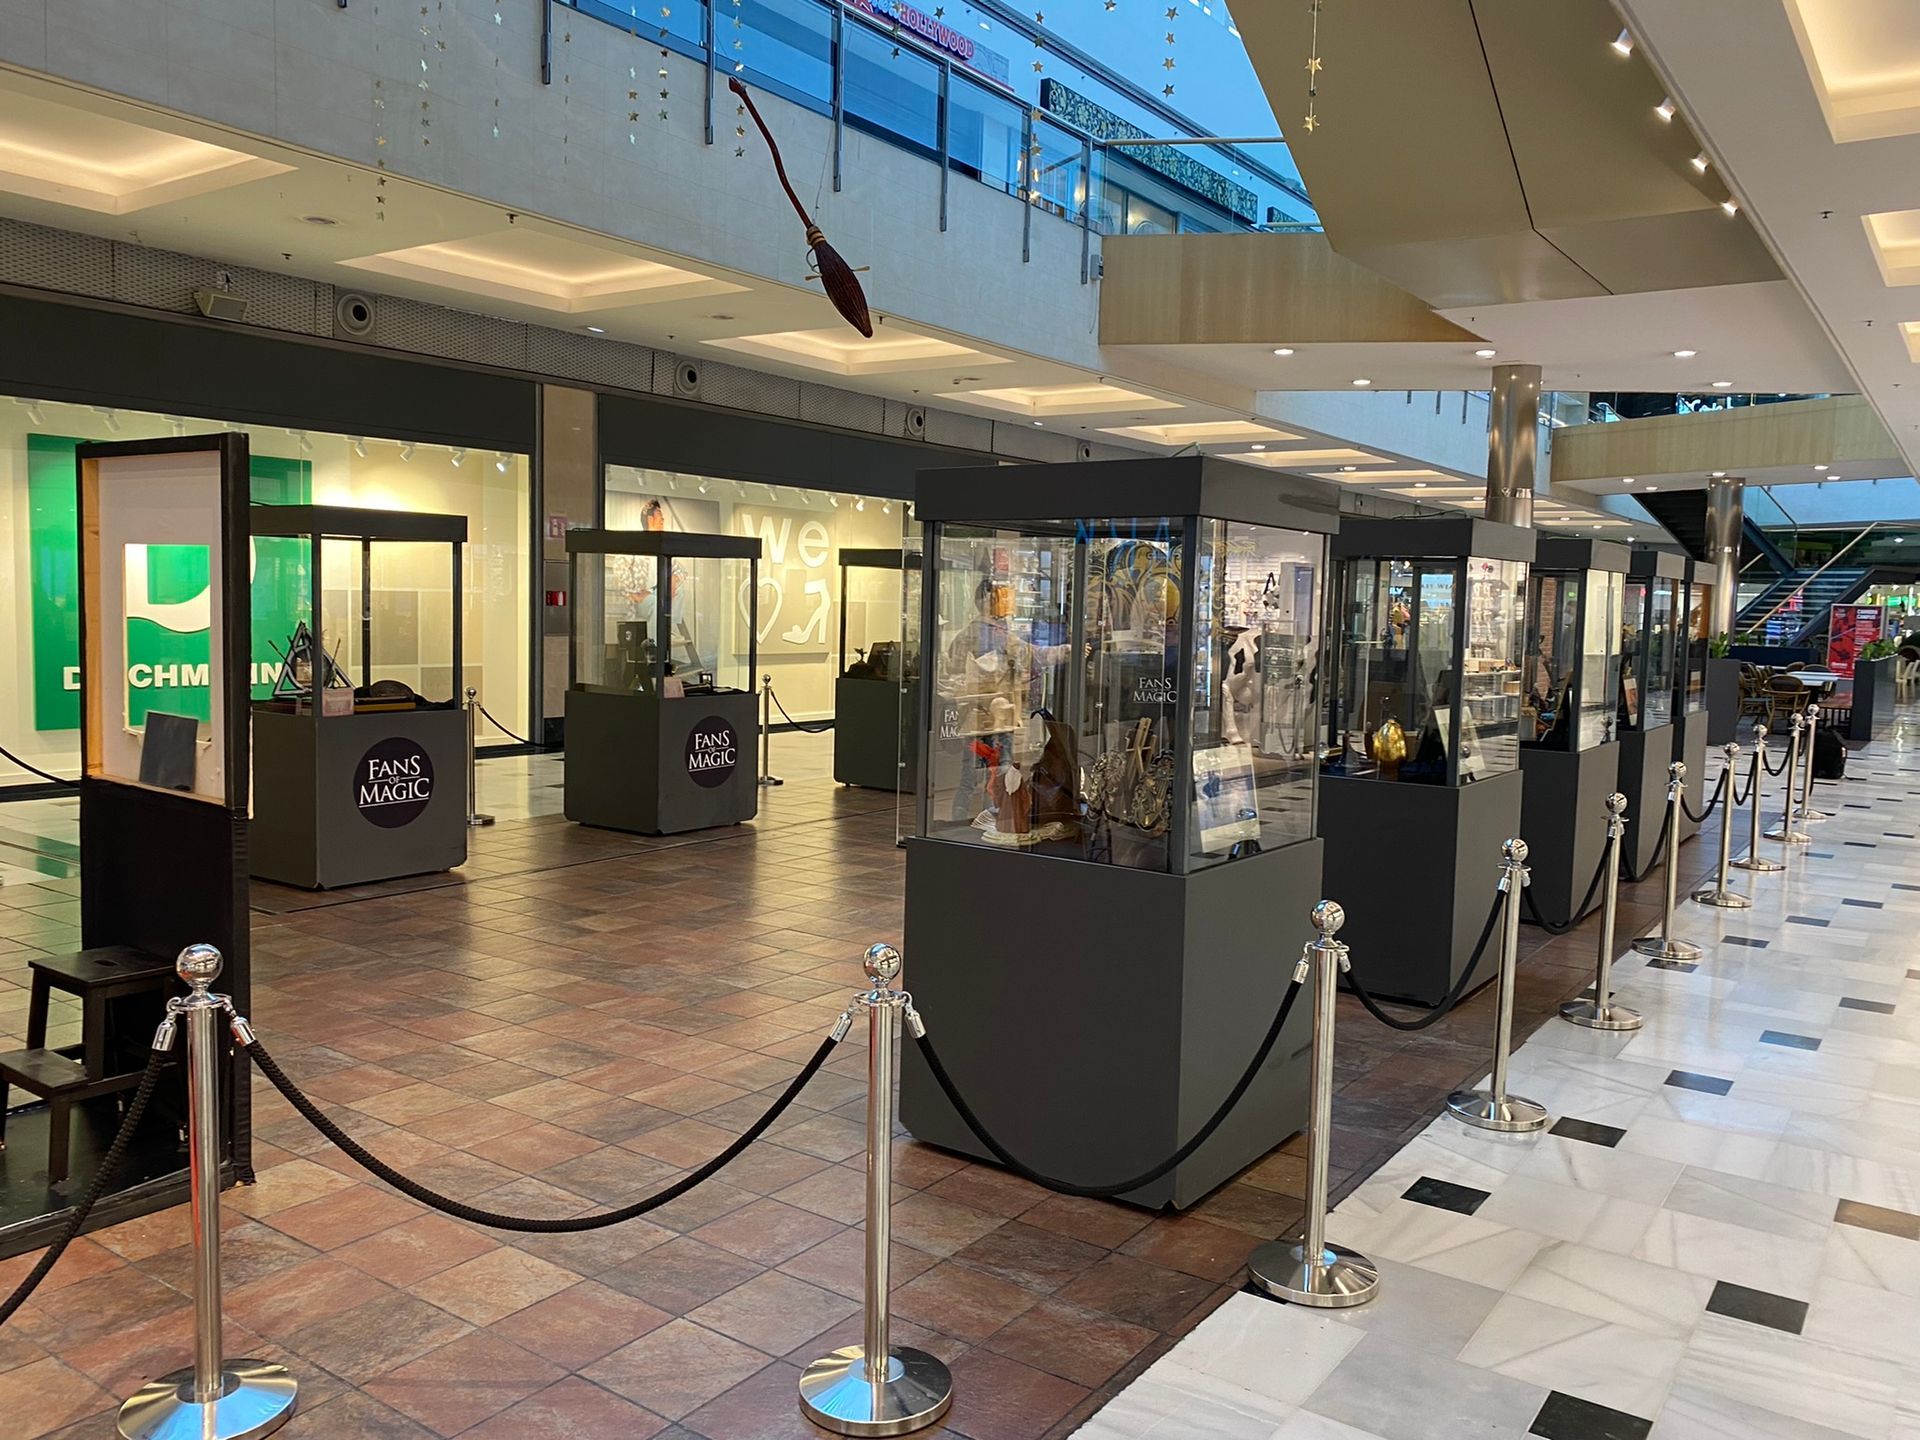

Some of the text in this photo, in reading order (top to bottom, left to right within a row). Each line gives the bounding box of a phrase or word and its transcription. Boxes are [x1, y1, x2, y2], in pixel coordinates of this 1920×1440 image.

[898, 3, 975, 59] HOLLYWOOD
[1139, 676, 1172, 689] FANS
[1133, 690, 1177, 703] MAGIC
[695, 730, 730, 750] FANS
[368, 755, 421, 780] FANS
[689, 748, 736, 770] MAGIC
[359, 777, 430, 805] MAGIC
[388, 776, 400, 785] OF
